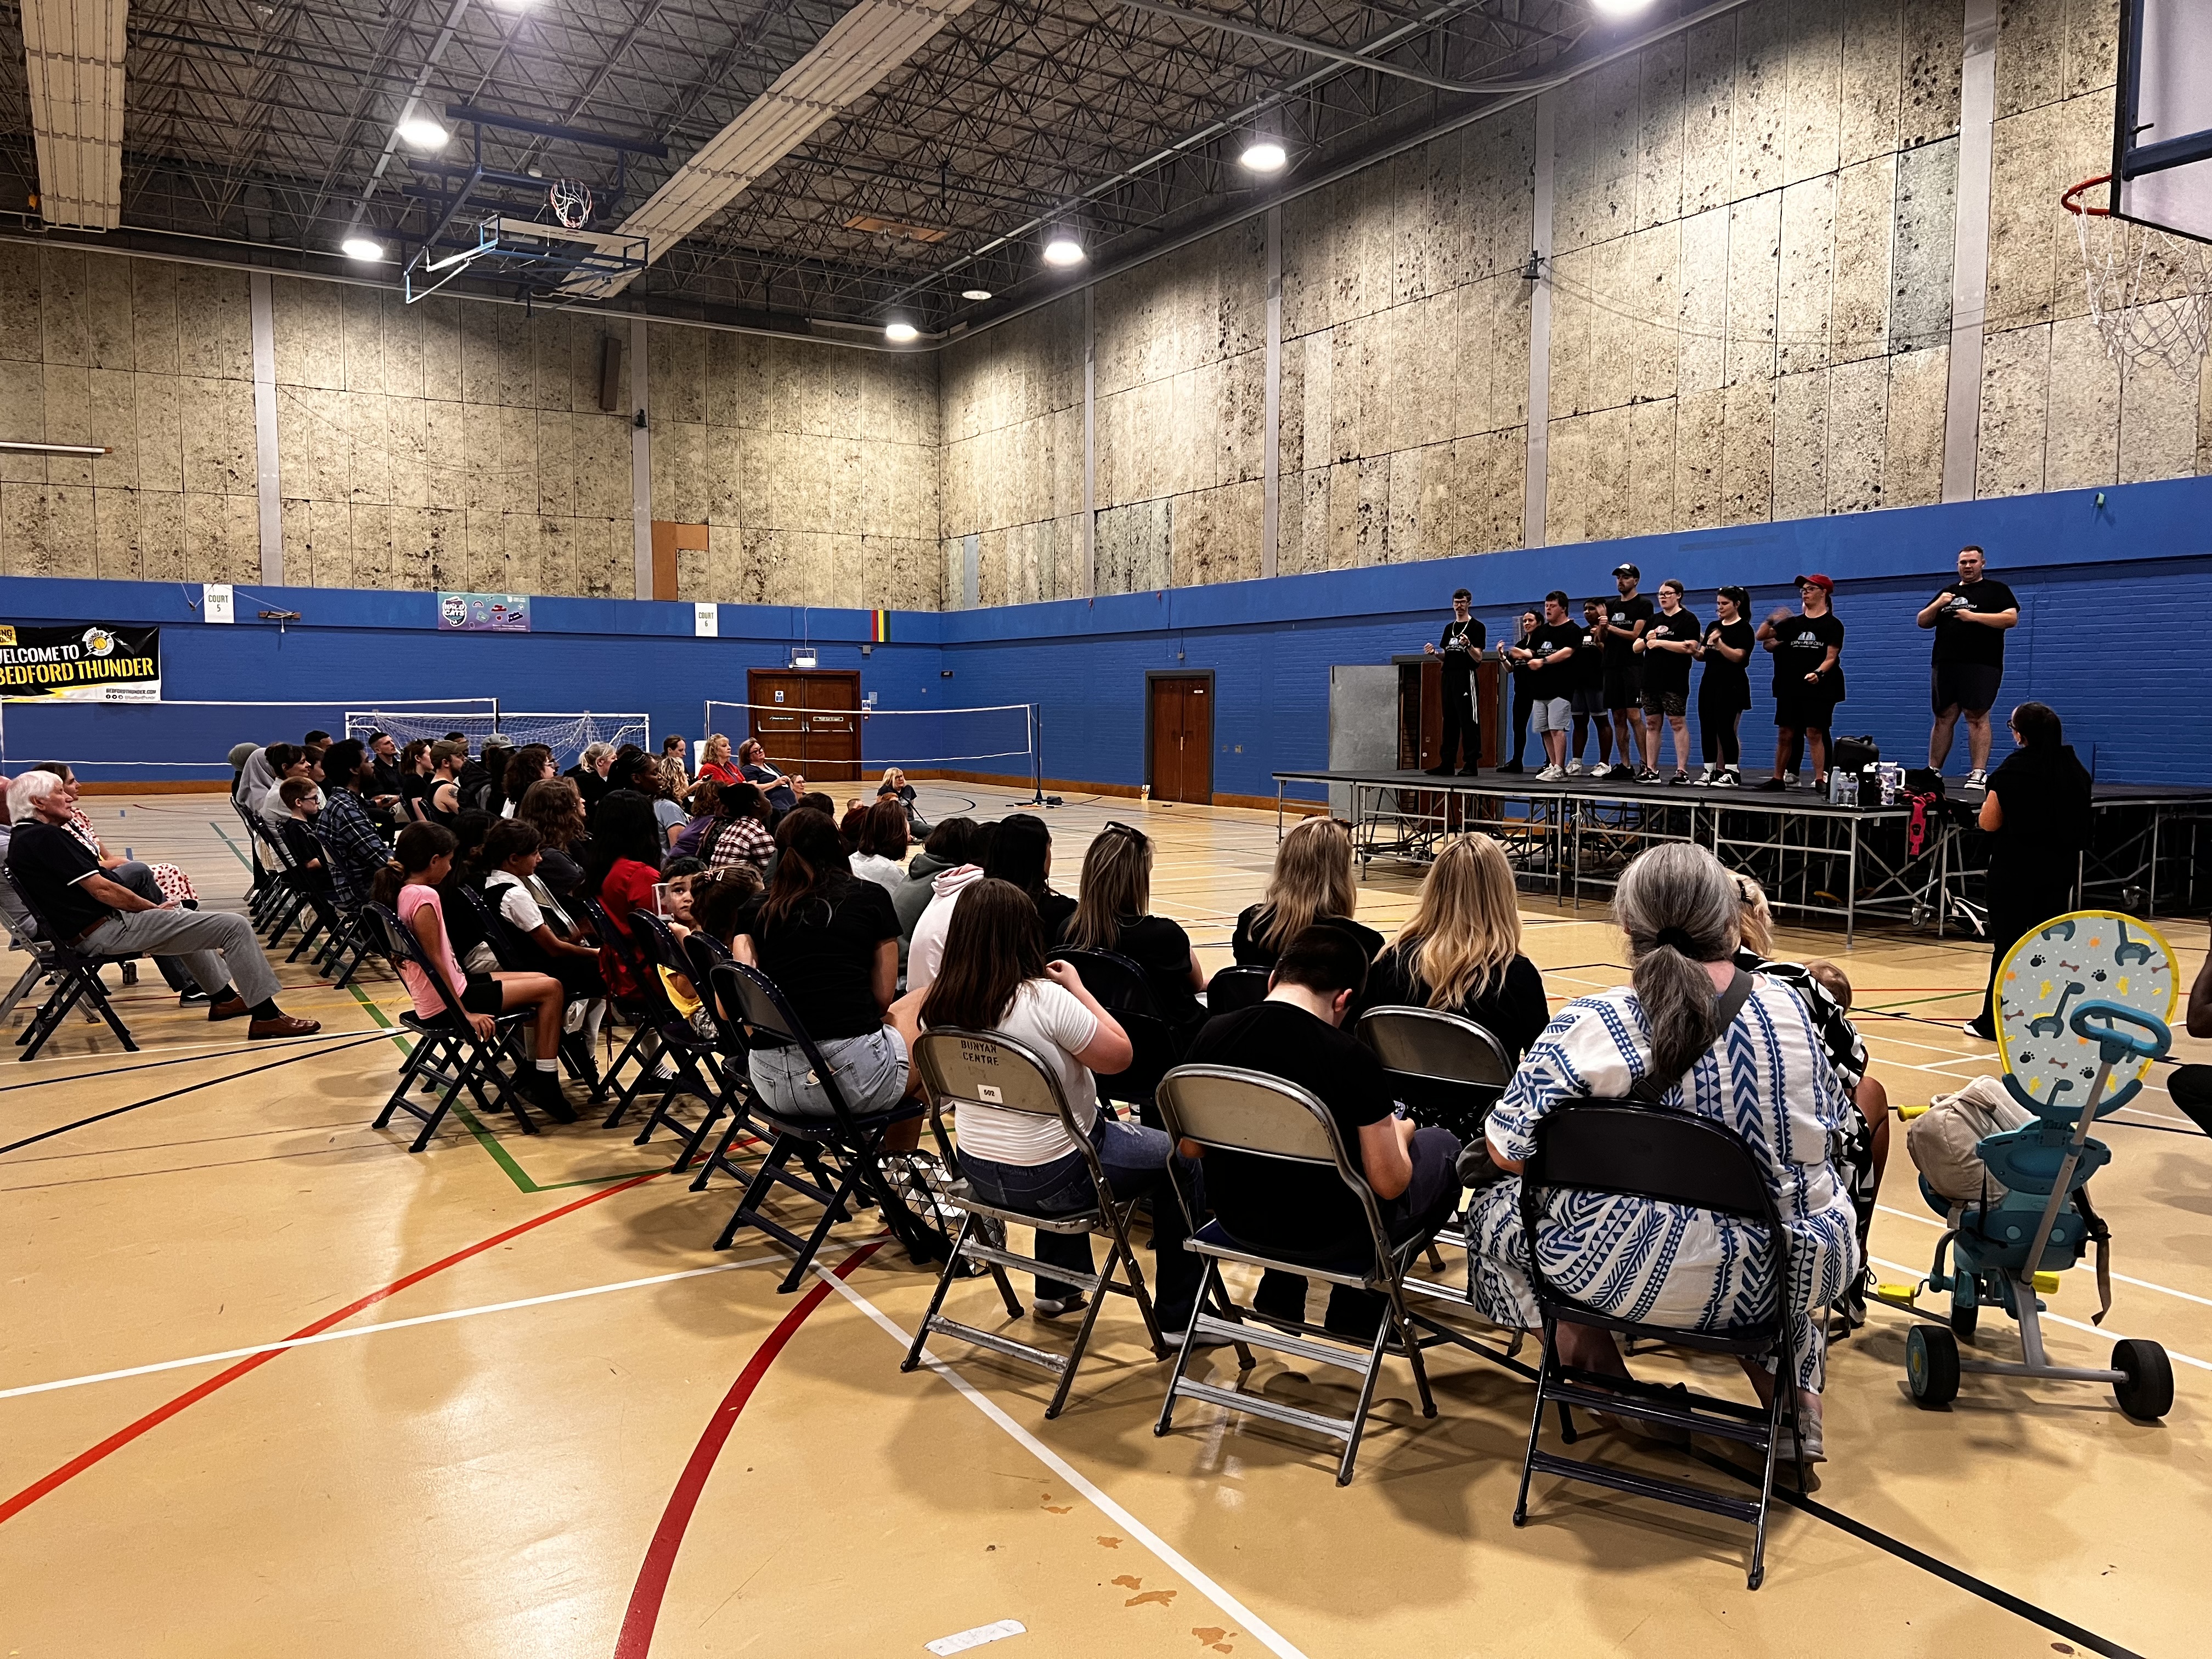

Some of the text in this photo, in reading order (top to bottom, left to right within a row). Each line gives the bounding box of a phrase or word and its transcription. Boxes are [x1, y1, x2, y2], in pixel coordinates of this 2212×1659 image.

[208, 595, 228, 603] COURT
[60, 644, 80, 660] TO
[75, 658, 154, 679] THUNDER
[961, 1040, 997, 1053] BUNYAN
[963, 1052, 999, 1065] CENTRE
